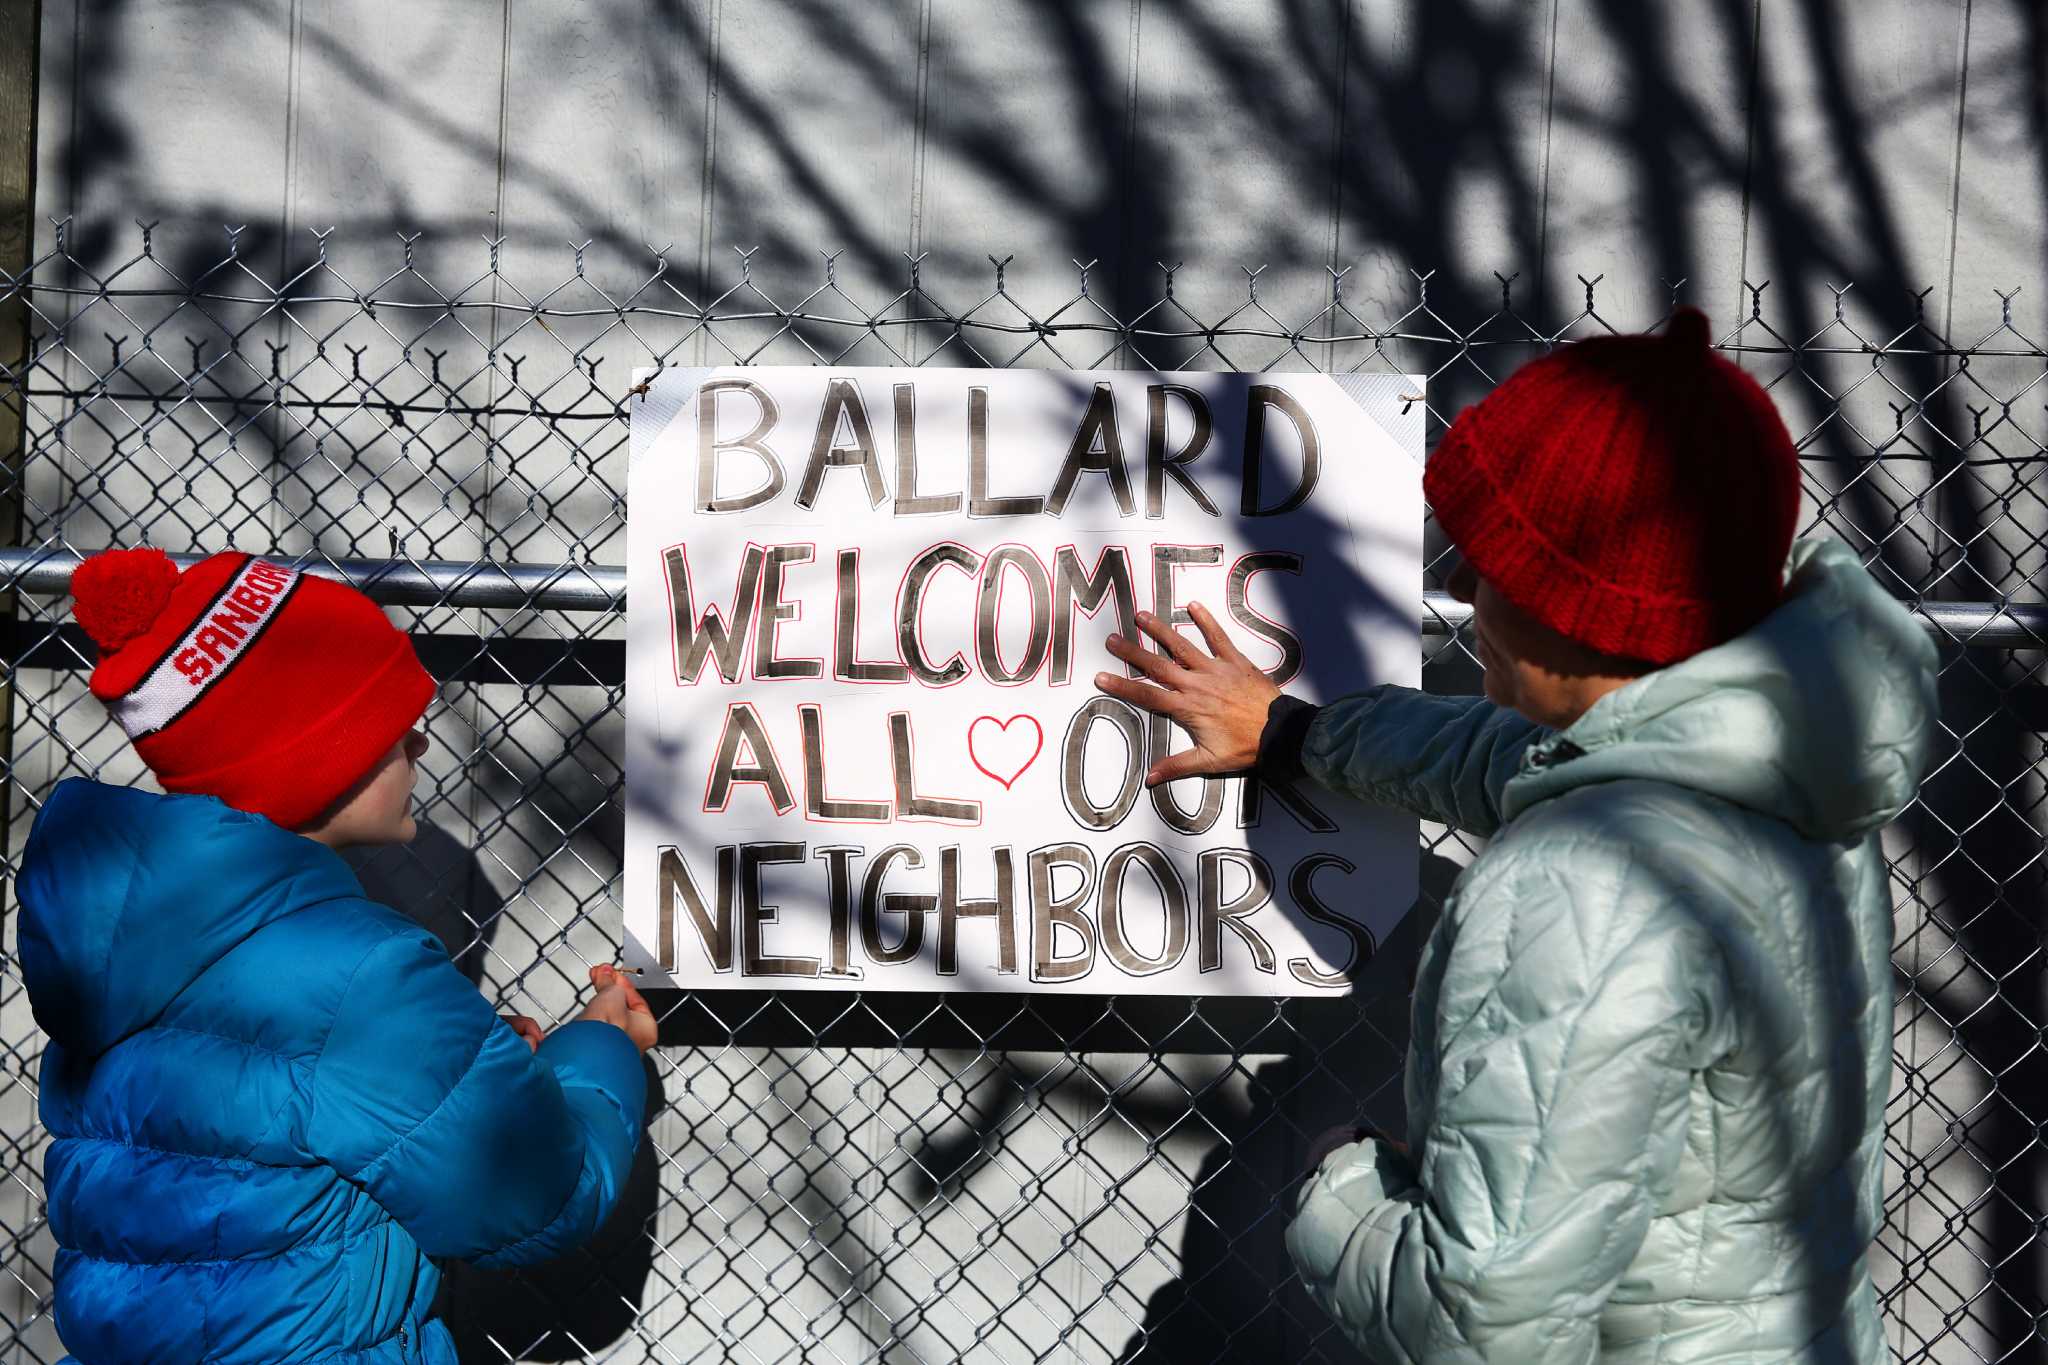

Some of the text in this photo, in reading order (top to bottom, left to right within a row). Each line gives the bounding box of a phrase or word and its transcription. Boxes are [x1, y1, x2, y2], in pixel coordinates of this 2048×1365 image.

[693, 377, 1322, 519] BALLARD
[660, 541, 1304, 688] WELCOMES
[702, 702, 984, 827] ALL
[654, 840, 1377, 988] NEIGHBORS
